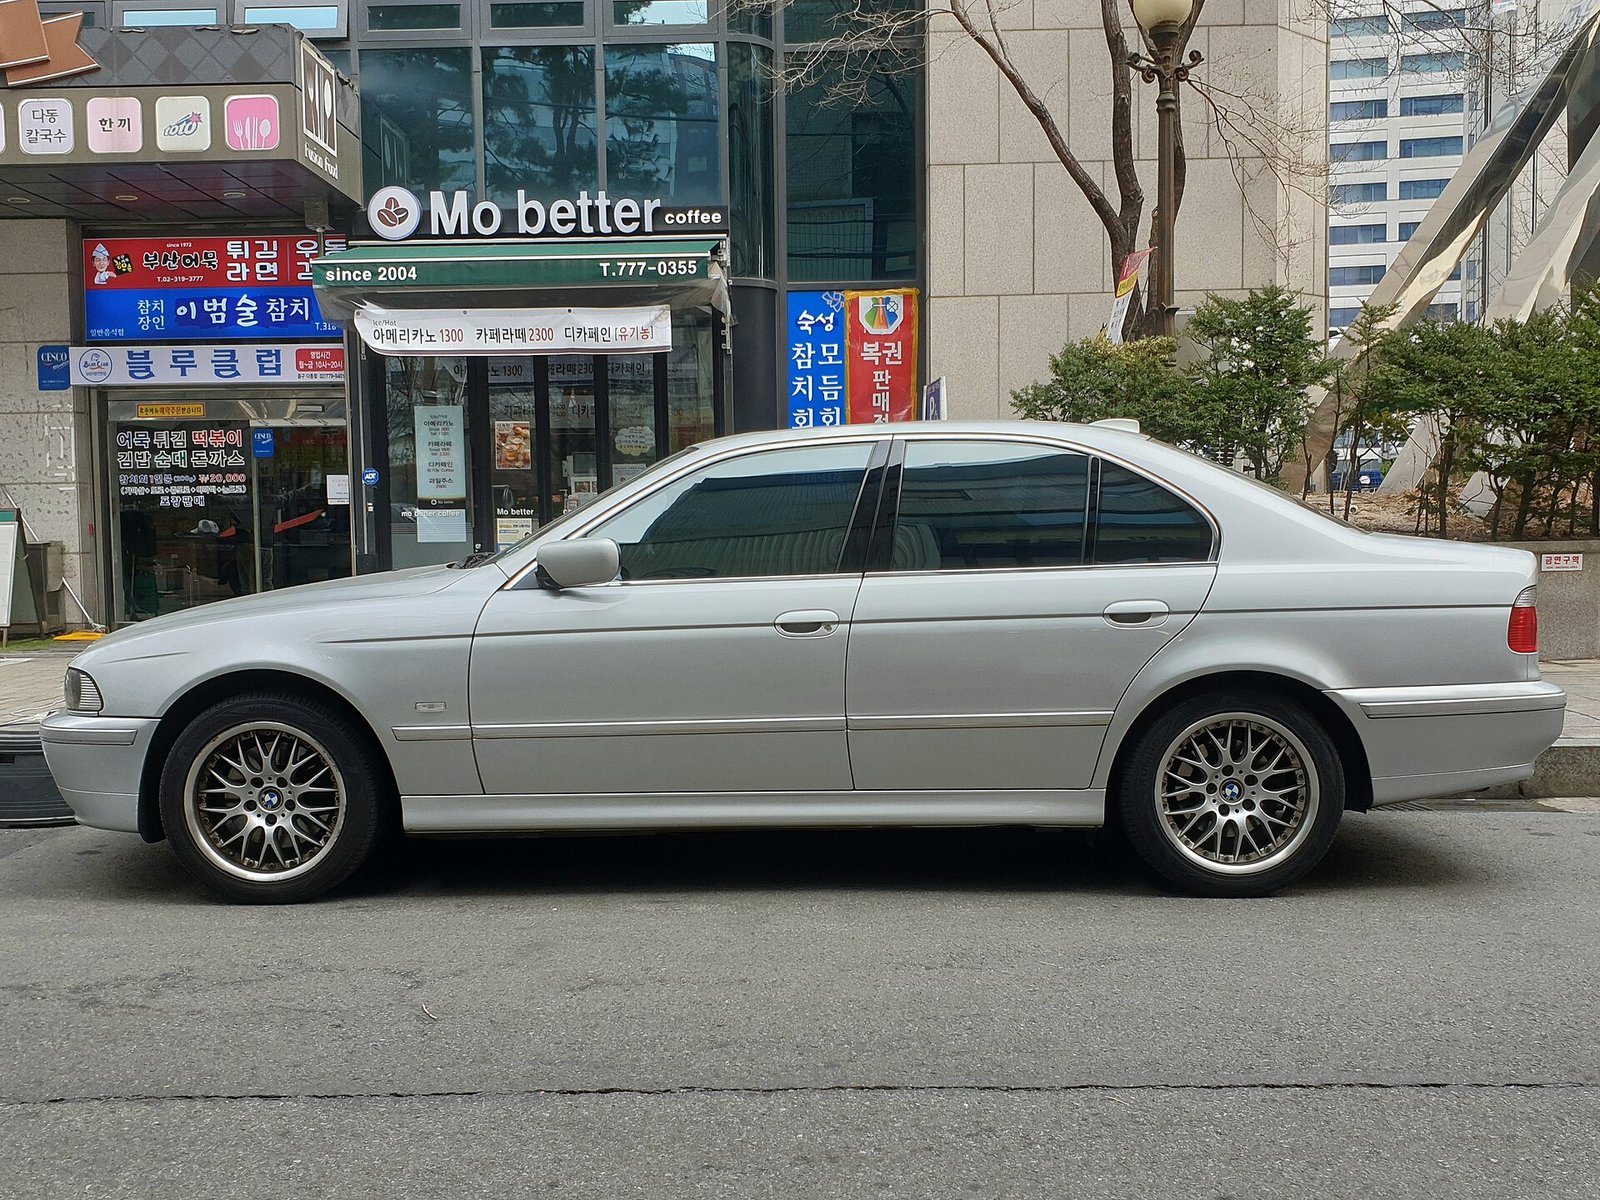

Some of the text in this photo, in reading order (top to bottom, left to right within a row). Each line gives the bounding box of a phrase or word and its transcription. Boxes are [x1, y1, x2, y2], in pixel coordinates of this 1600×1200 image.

[32, 108, 59, 124] 다동
[26, 129, 67, 144] 칼국수
[162, 123, 198, 136] toto
[324, 157, 339, 180] Food
[430, 189, 722, 236] Mo better coffee
[226, 240, 277, 259] 튀김
[226, 262, 278, 281] 라면
[325, 266, 417, 281] since 2004
[599, 260, 697, 277] T.777-0355
[137, 299, 164, 315] 참치
[138, 315, 165, 331] 장인
[372, 319, 398, 327] Ice/Hot
[797, 309, 835, 335] 숙성
[373, 328, 438, 344] 아메리카노
[439, 328, 464, 343] 1300
[476, 328, 527, 344] 카페라떼
[528, 327, 554, 342] 2300
[564, 326, 612, 343] 디카페인
[861, 341, 902, 365] 복권
[116, 429, 243, 449] 어묵 튀김 떡볶이
[117, 450, 245, 469] 김밥 순대 돈까스
[160, 495, 205, 508] 포장판매
[496, 508, 534, 516] Mo better
[1545, 555, 1580, 565] 금연구역
